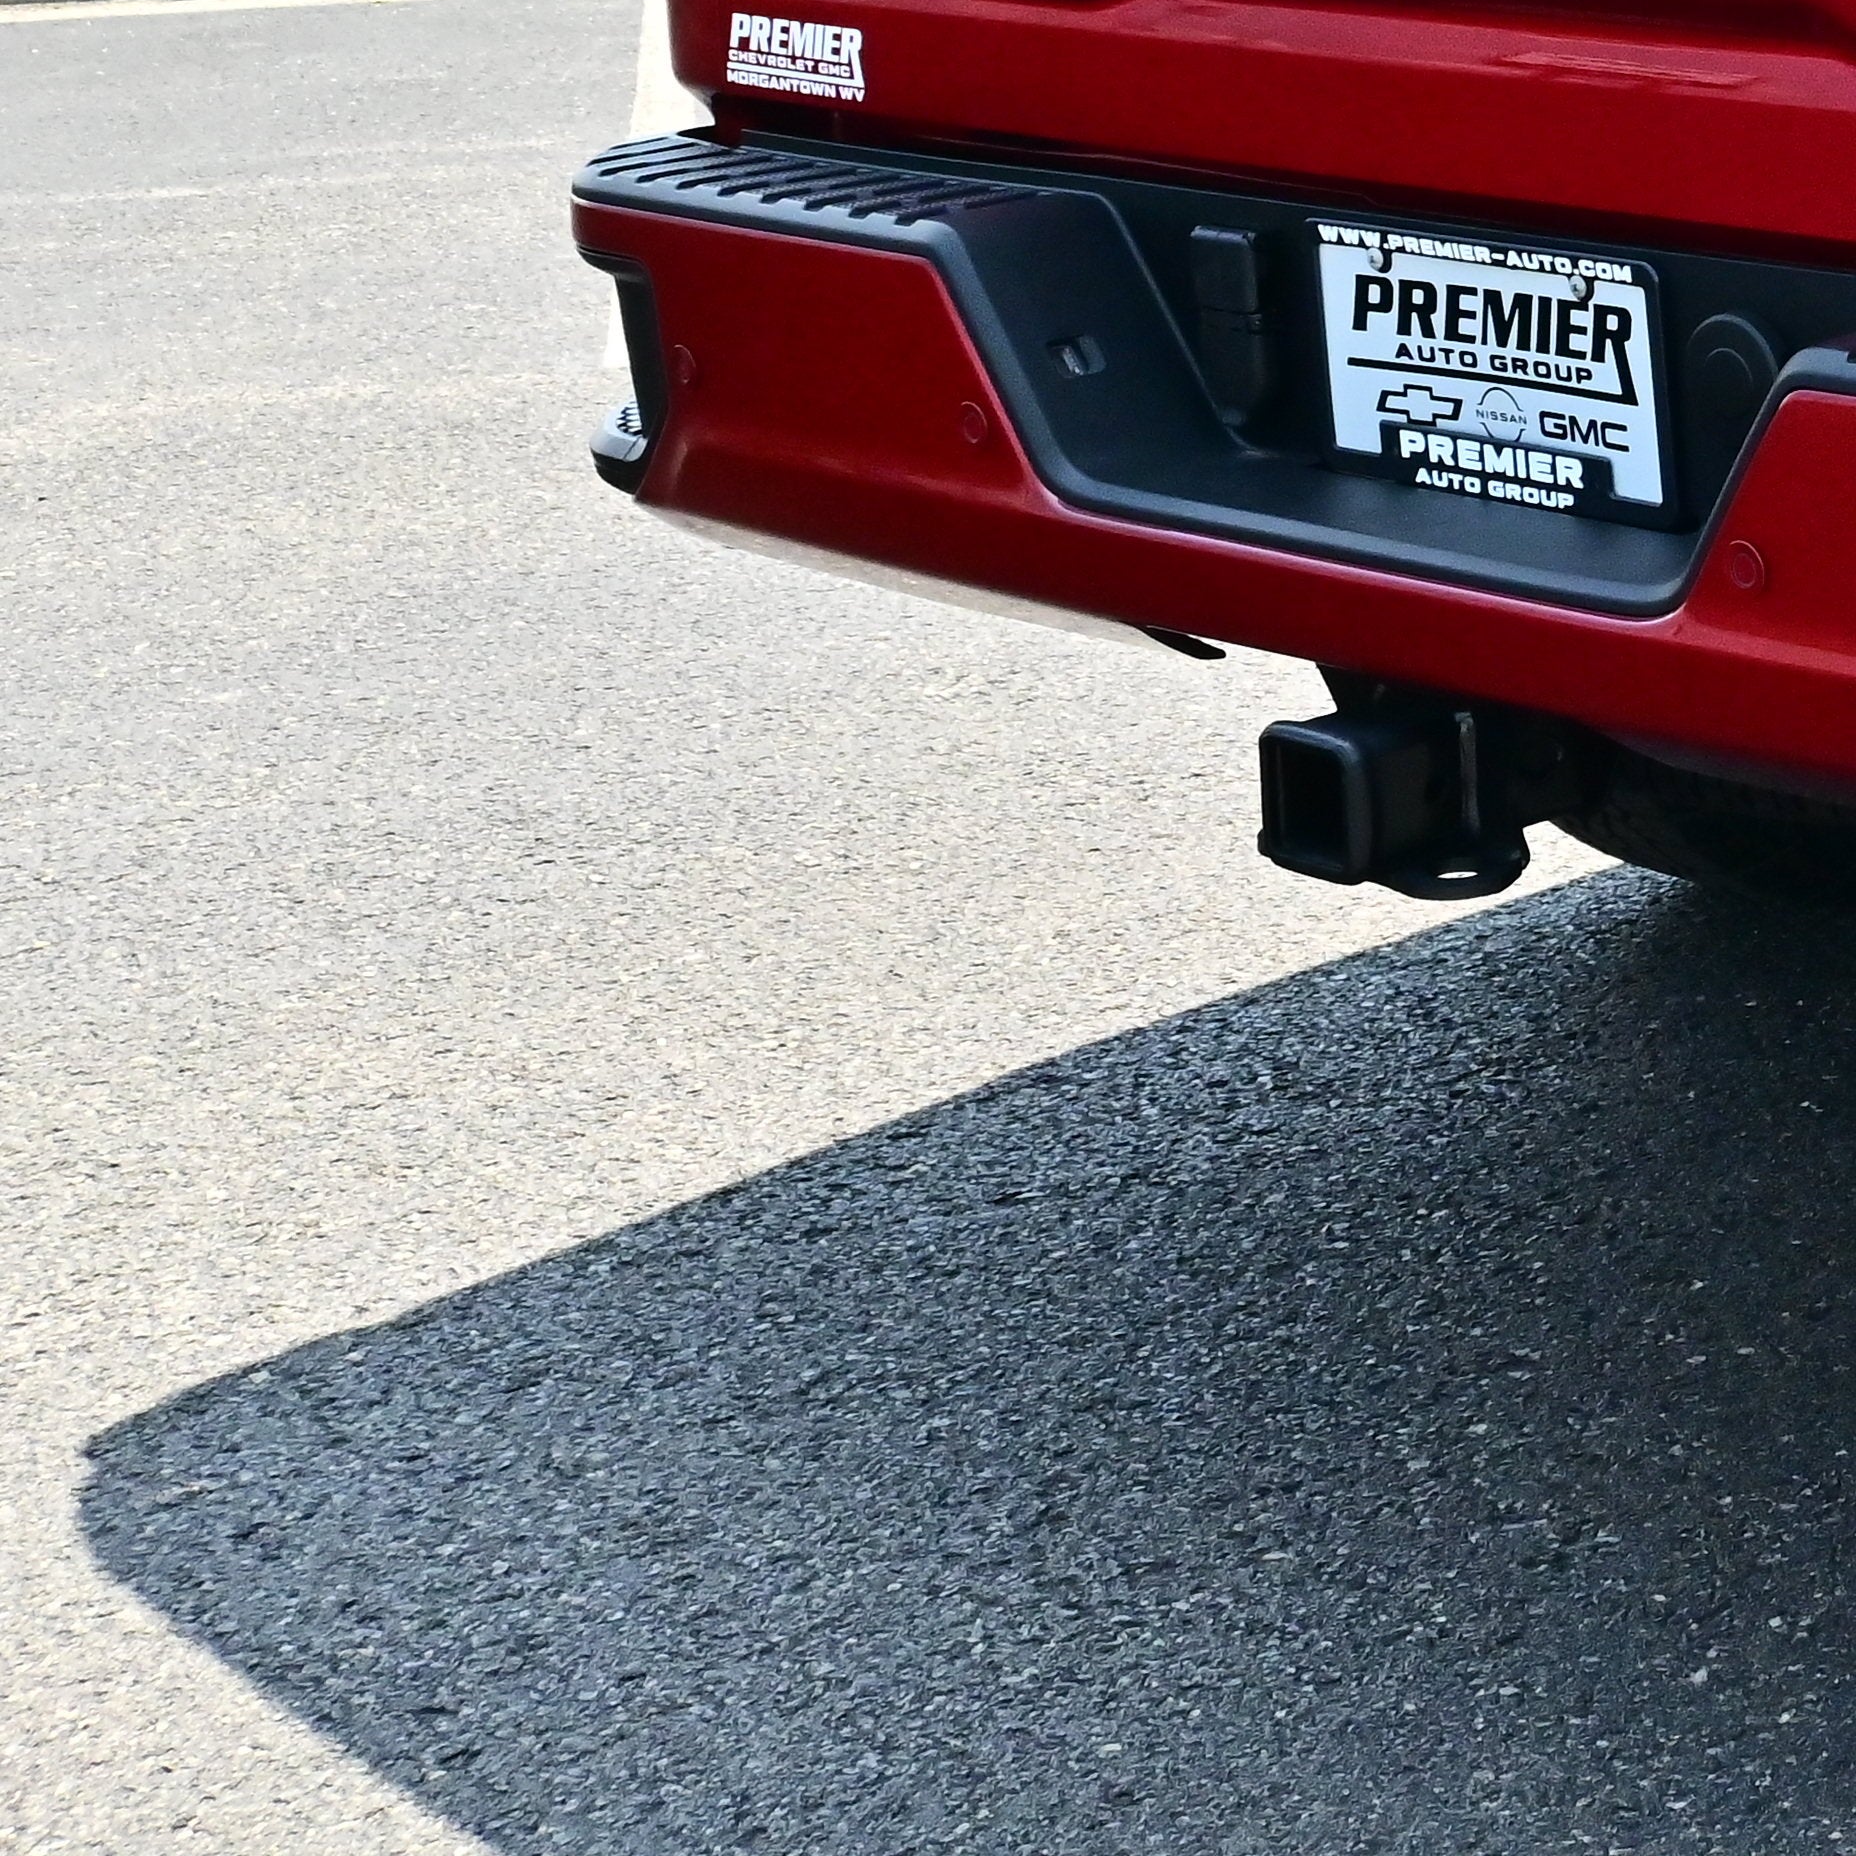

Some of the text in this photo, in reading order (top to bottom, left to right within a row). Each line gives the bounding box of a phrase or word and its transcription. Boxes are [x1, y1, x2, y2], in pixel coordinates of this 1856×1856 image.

[729, 13, 863, 64] PREMIER
[728, 49, 850, 77] CHEVROLET GMC
[727, 69, 865, 102] MORGANTOWN WV
[1318, 224, 1632, 283] WWW.PREMIER-AUTO.COM
[1352, 274, 1634, 365] PREMIER
[1395, 342, 1594, 385] AUTO GROUP
[1475, 408, 1527, 426] NISSAN
[1539, 411, 1630, 453] GMC
[1399, 430, 1584, 489] PREMIER
[1415, 467, 1574, 509] AUTO GROUP
